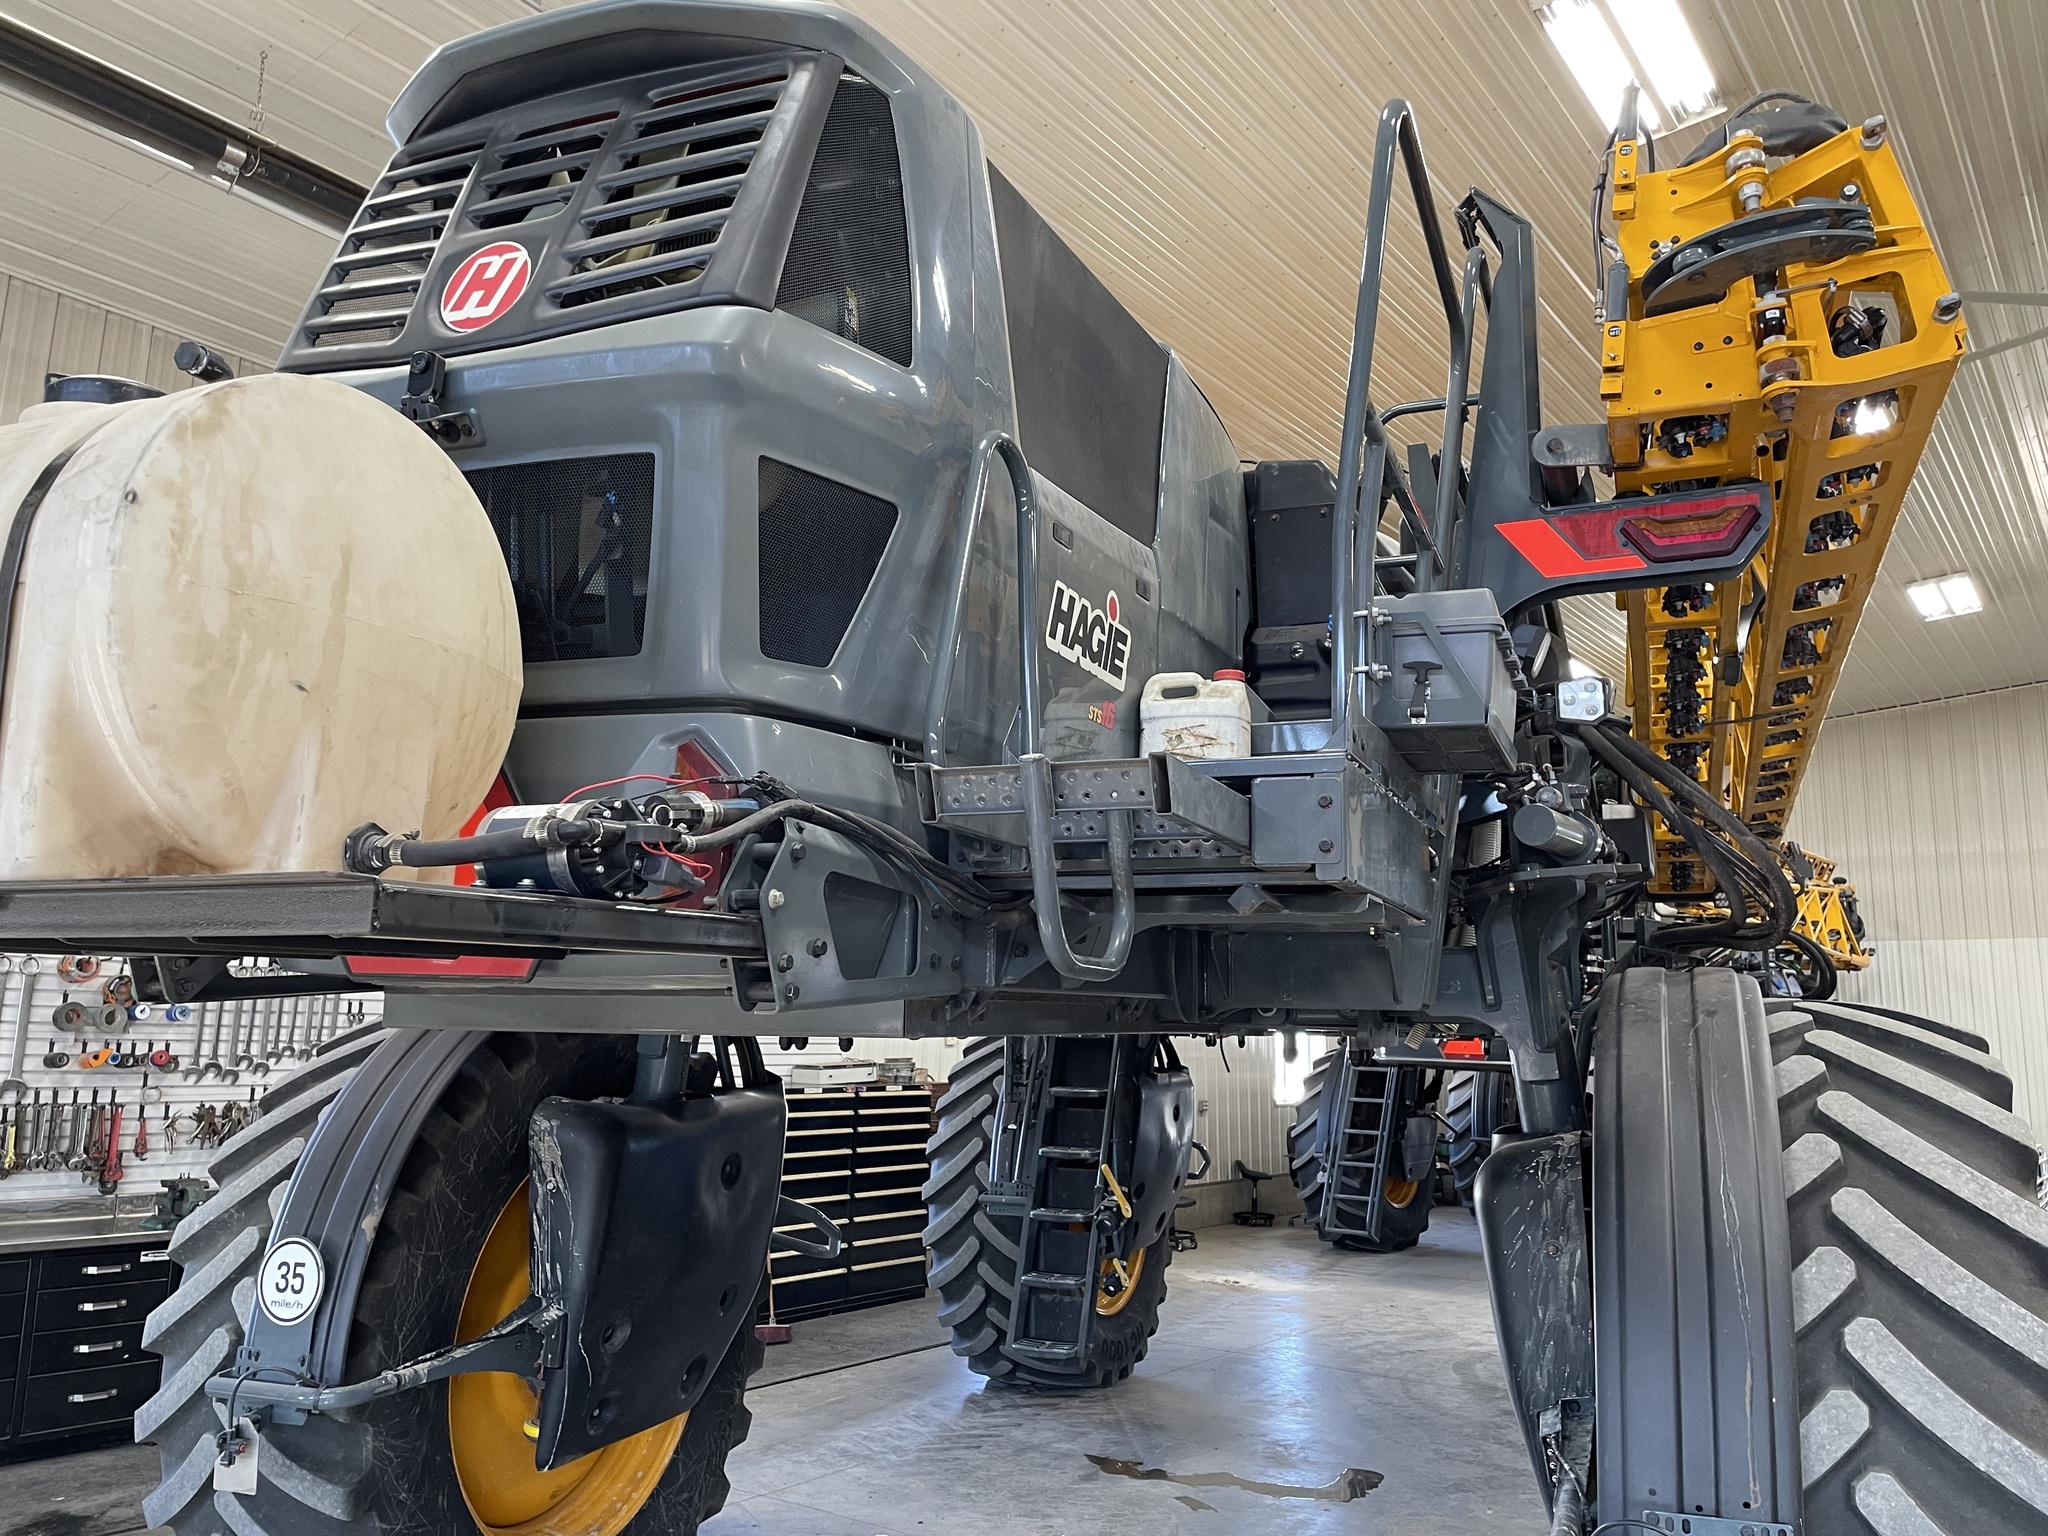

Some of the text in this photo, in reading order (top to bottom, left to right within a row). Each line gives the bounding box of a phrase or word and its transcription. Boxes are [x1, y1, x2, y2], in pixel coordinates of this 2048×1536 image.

[1049, 585, 1129, 682] HAGIE
[275, 1261, 306, 1294] 35
[270, 1299, 303, 1310] mile/h
